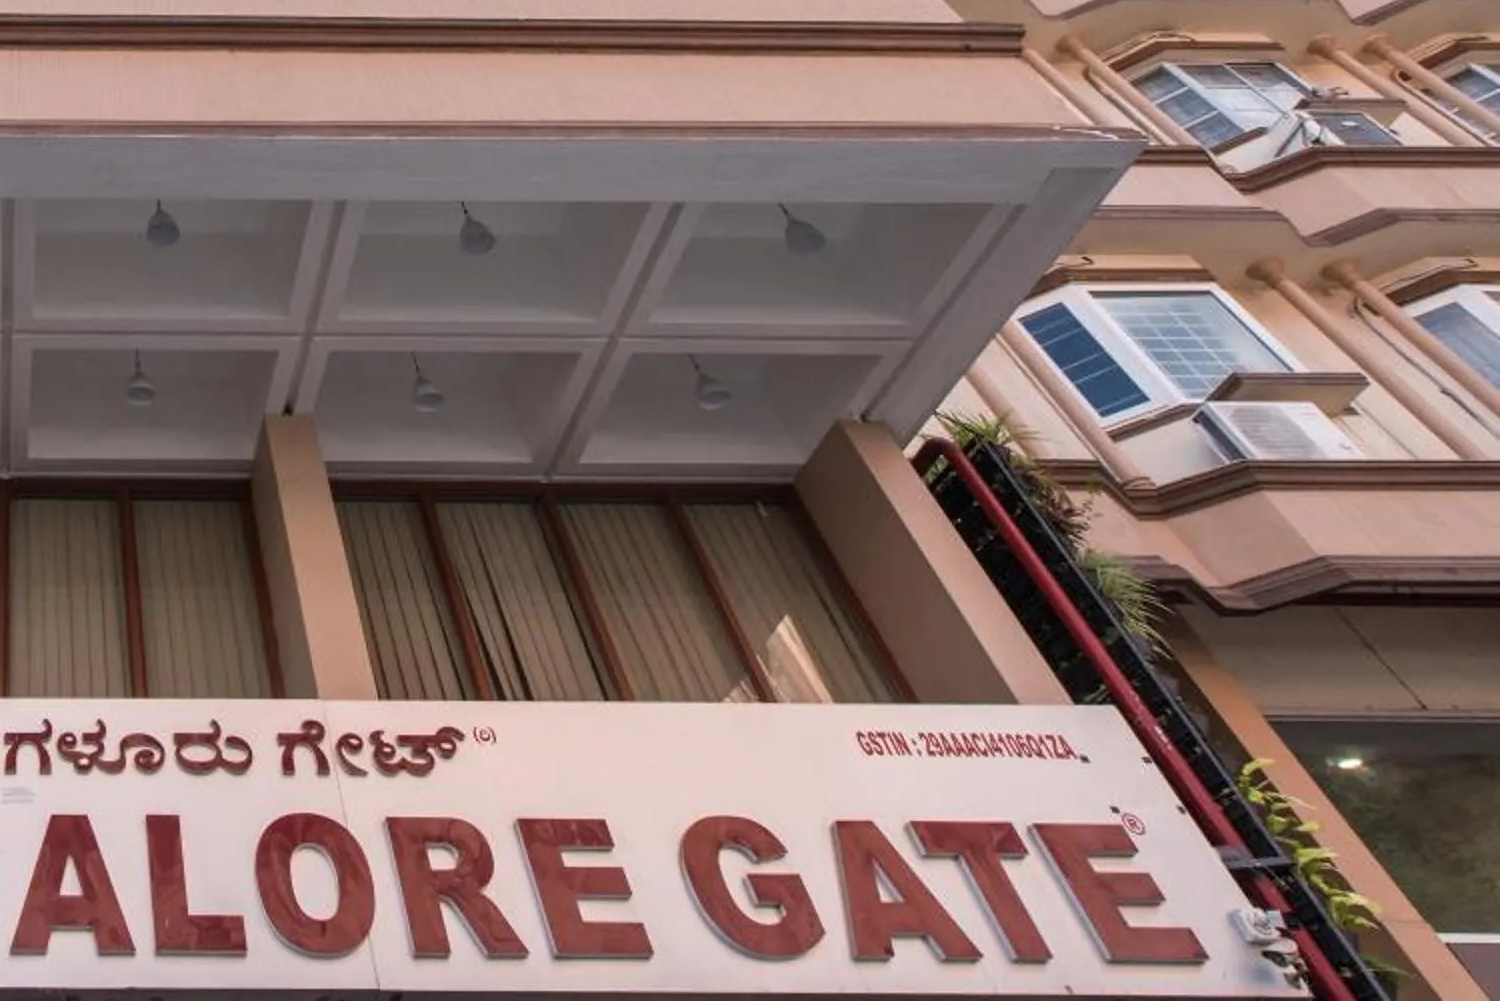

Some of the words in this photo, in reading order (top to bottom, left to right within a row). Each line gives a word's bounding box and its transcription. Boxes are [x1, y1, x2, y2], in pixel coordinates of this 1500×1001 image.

[276, 719, 465, 777] ಗೇಟ್
[856, 731, 913, 756] GSTIN
[679, 814, 1210, 965] GATE
